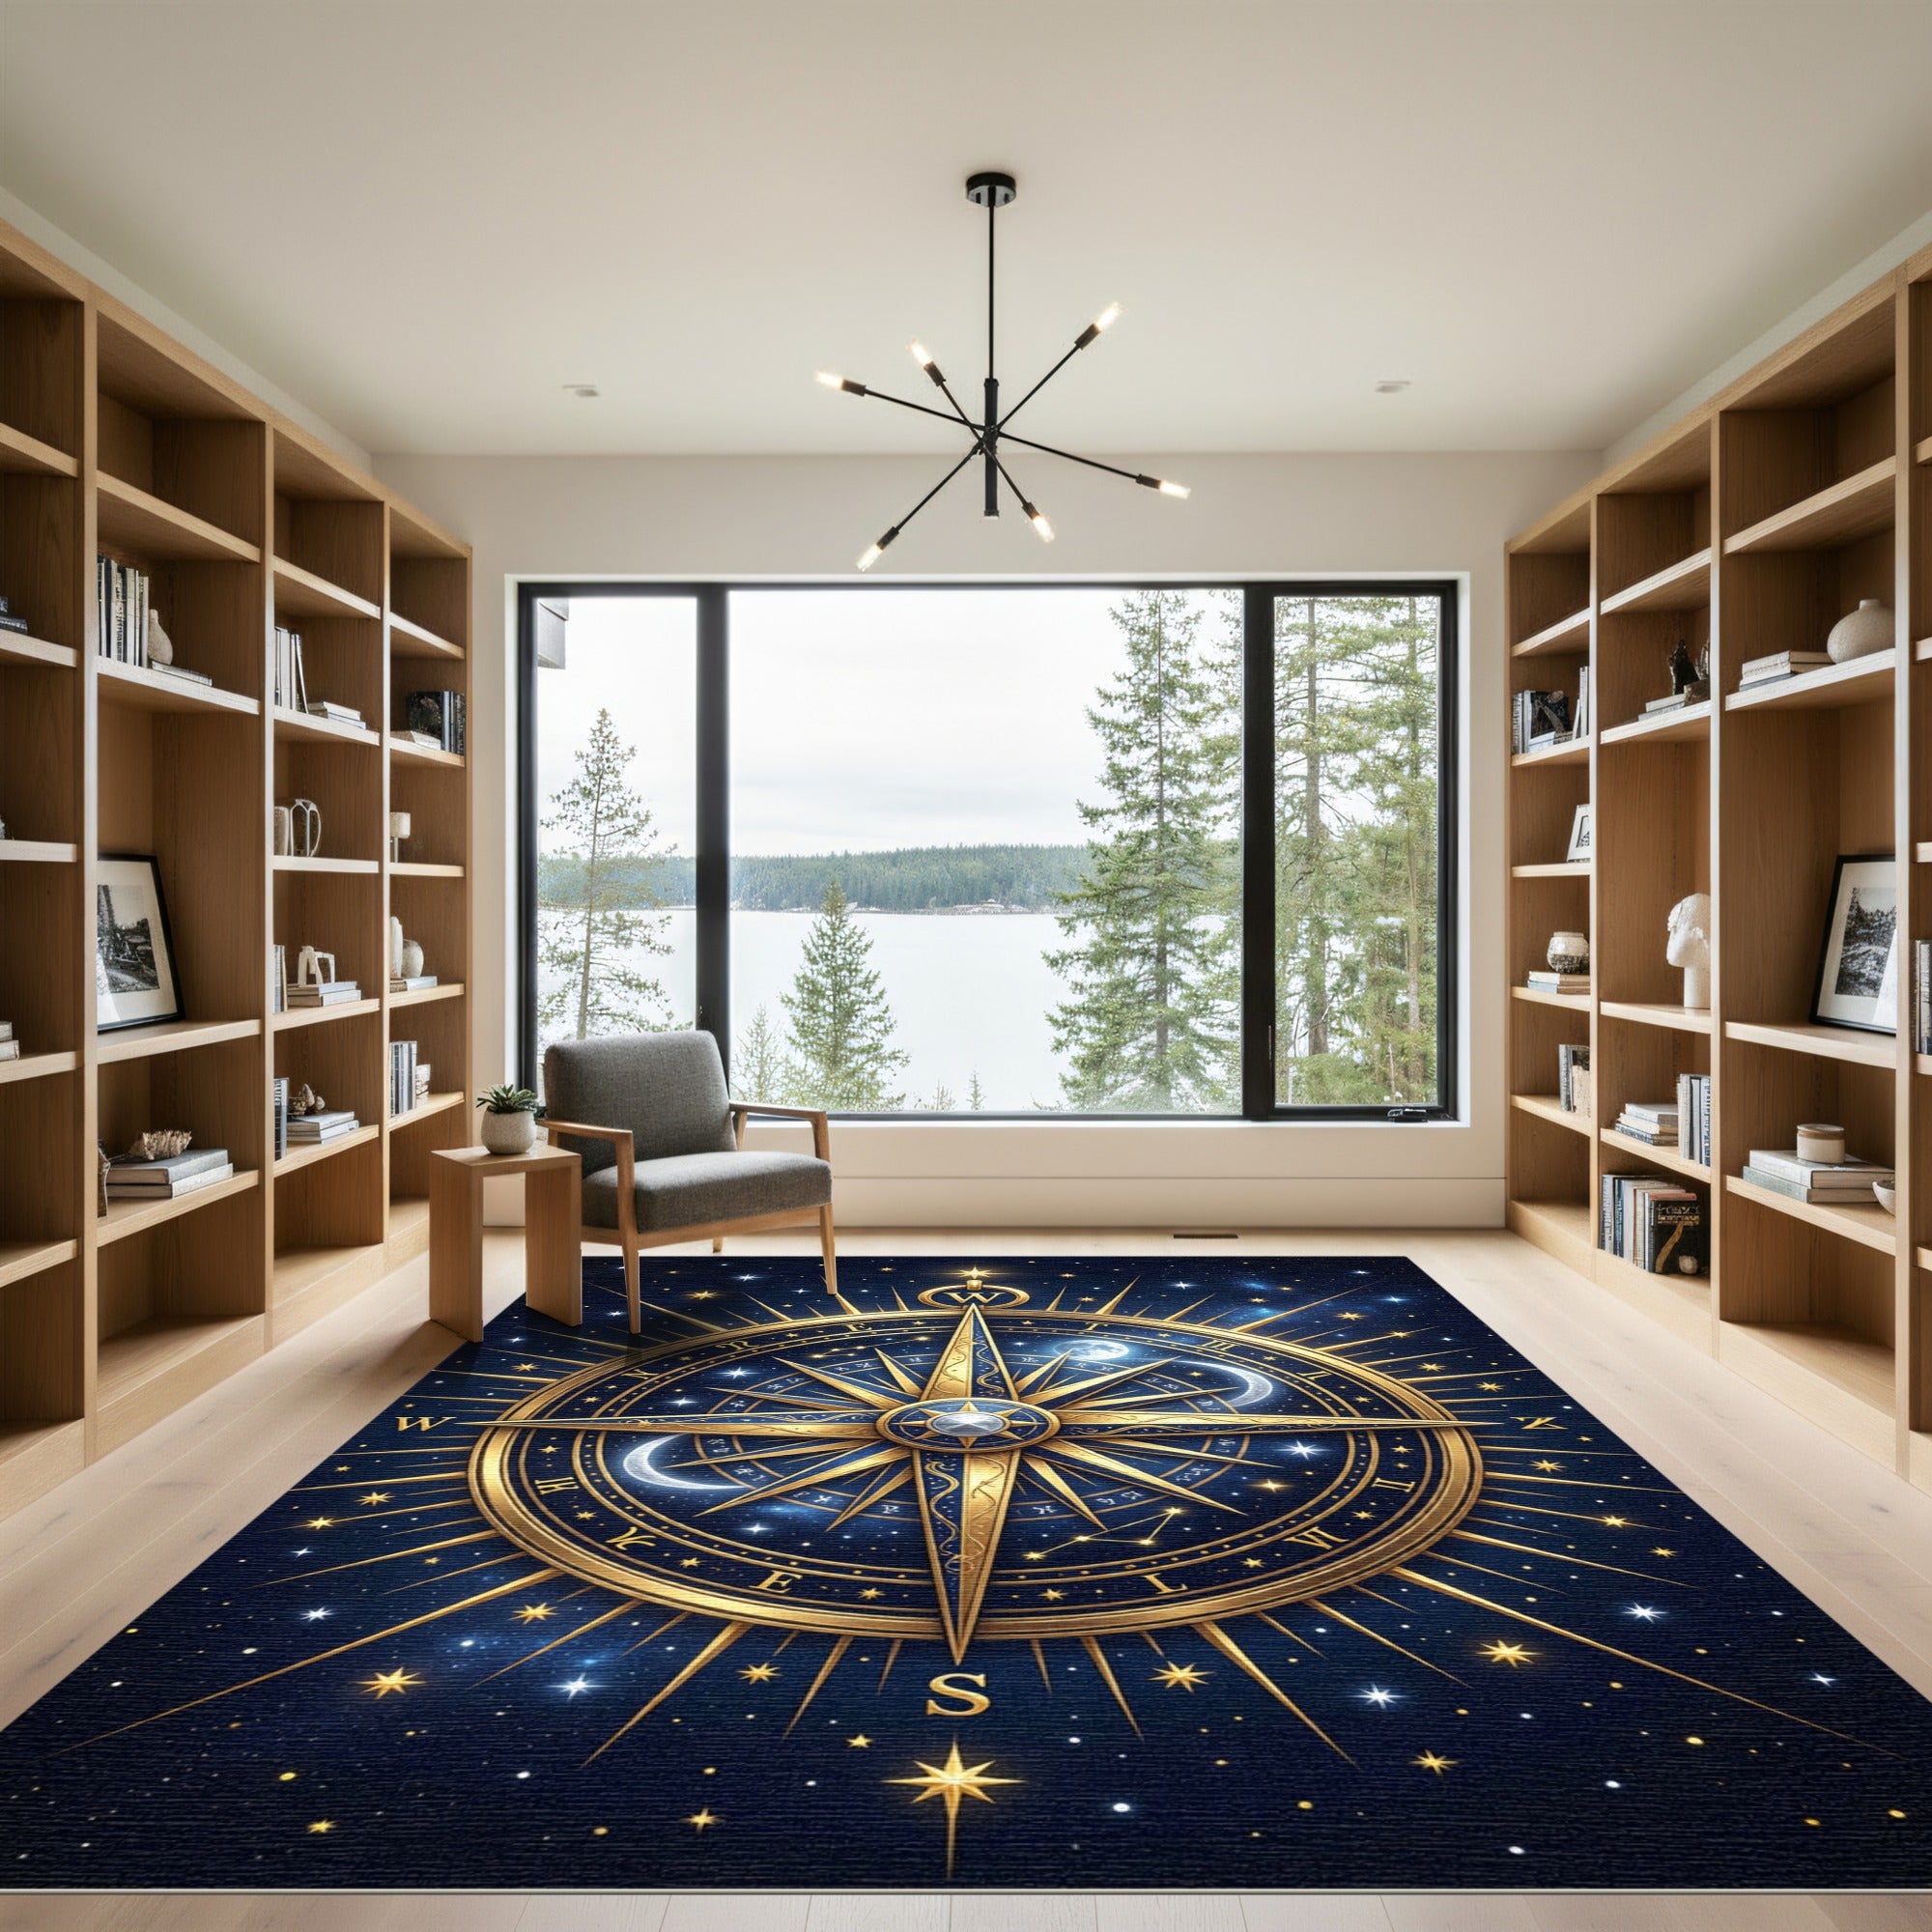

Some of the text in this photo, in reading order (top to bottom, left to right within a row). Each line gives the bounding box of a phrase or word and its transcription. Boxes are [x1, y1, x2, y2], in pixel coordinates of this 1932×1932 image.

[943, 1292, 1005, 1303] W
[394, 1416, 457, 1432] W
[748, 1570, 804, 1594] E
[925, 1672, 991, 1717] S
